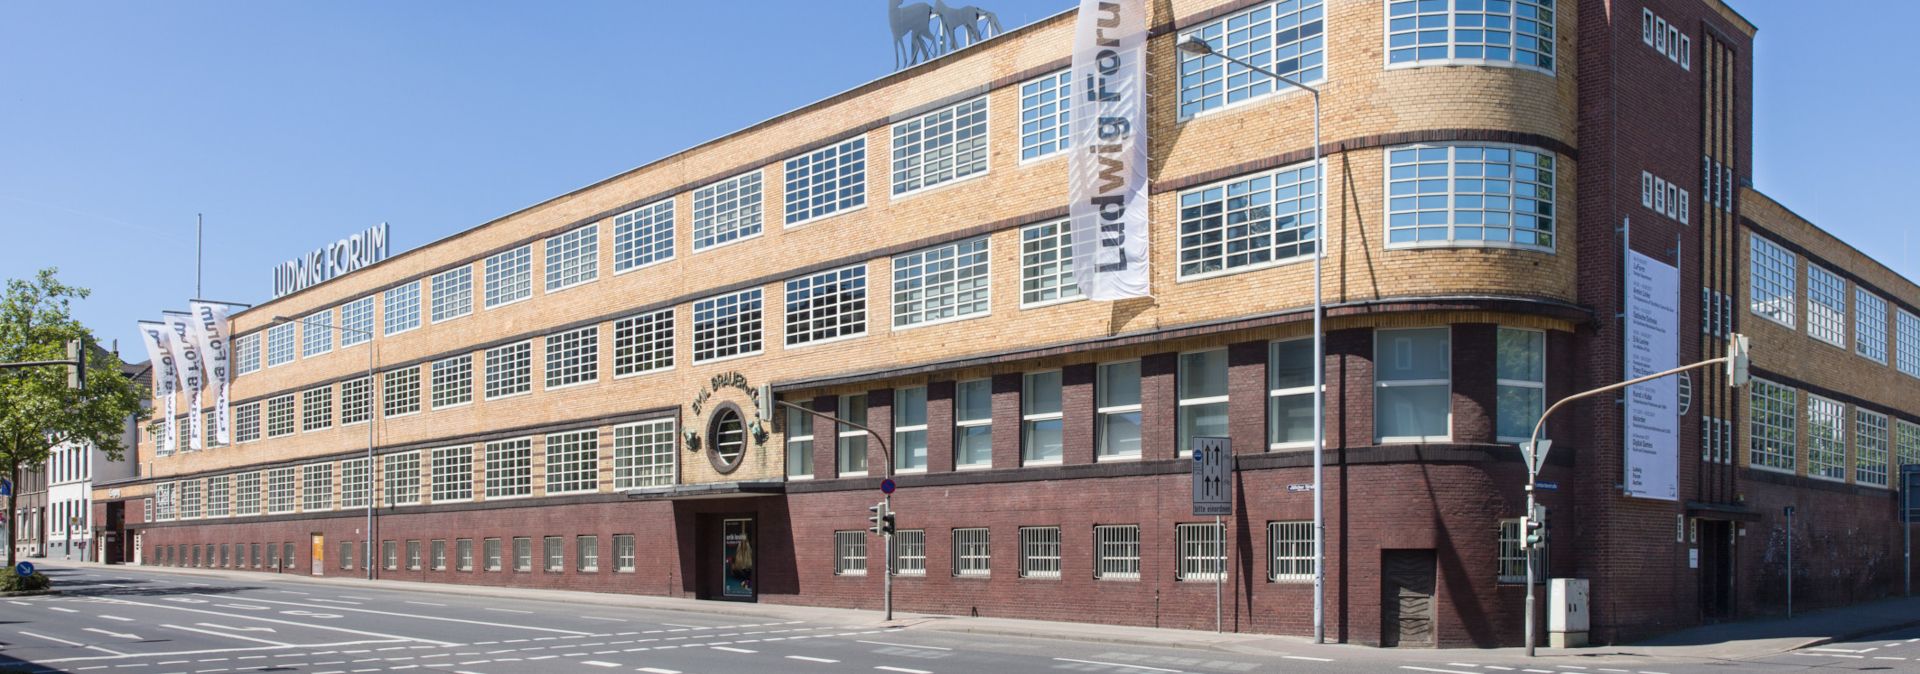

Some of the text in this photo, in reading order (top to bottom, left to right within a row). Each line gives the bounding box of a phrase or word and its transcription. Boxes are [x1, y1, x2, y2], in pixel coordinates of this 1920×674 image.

[1087, 2, 1130, 273] Ludwig Foru
[273, 222, 389, 298] LUDWIG FORUM
[692, 386, 711, 416] EMIL
[711, 371, 747, 392] BRAUER
